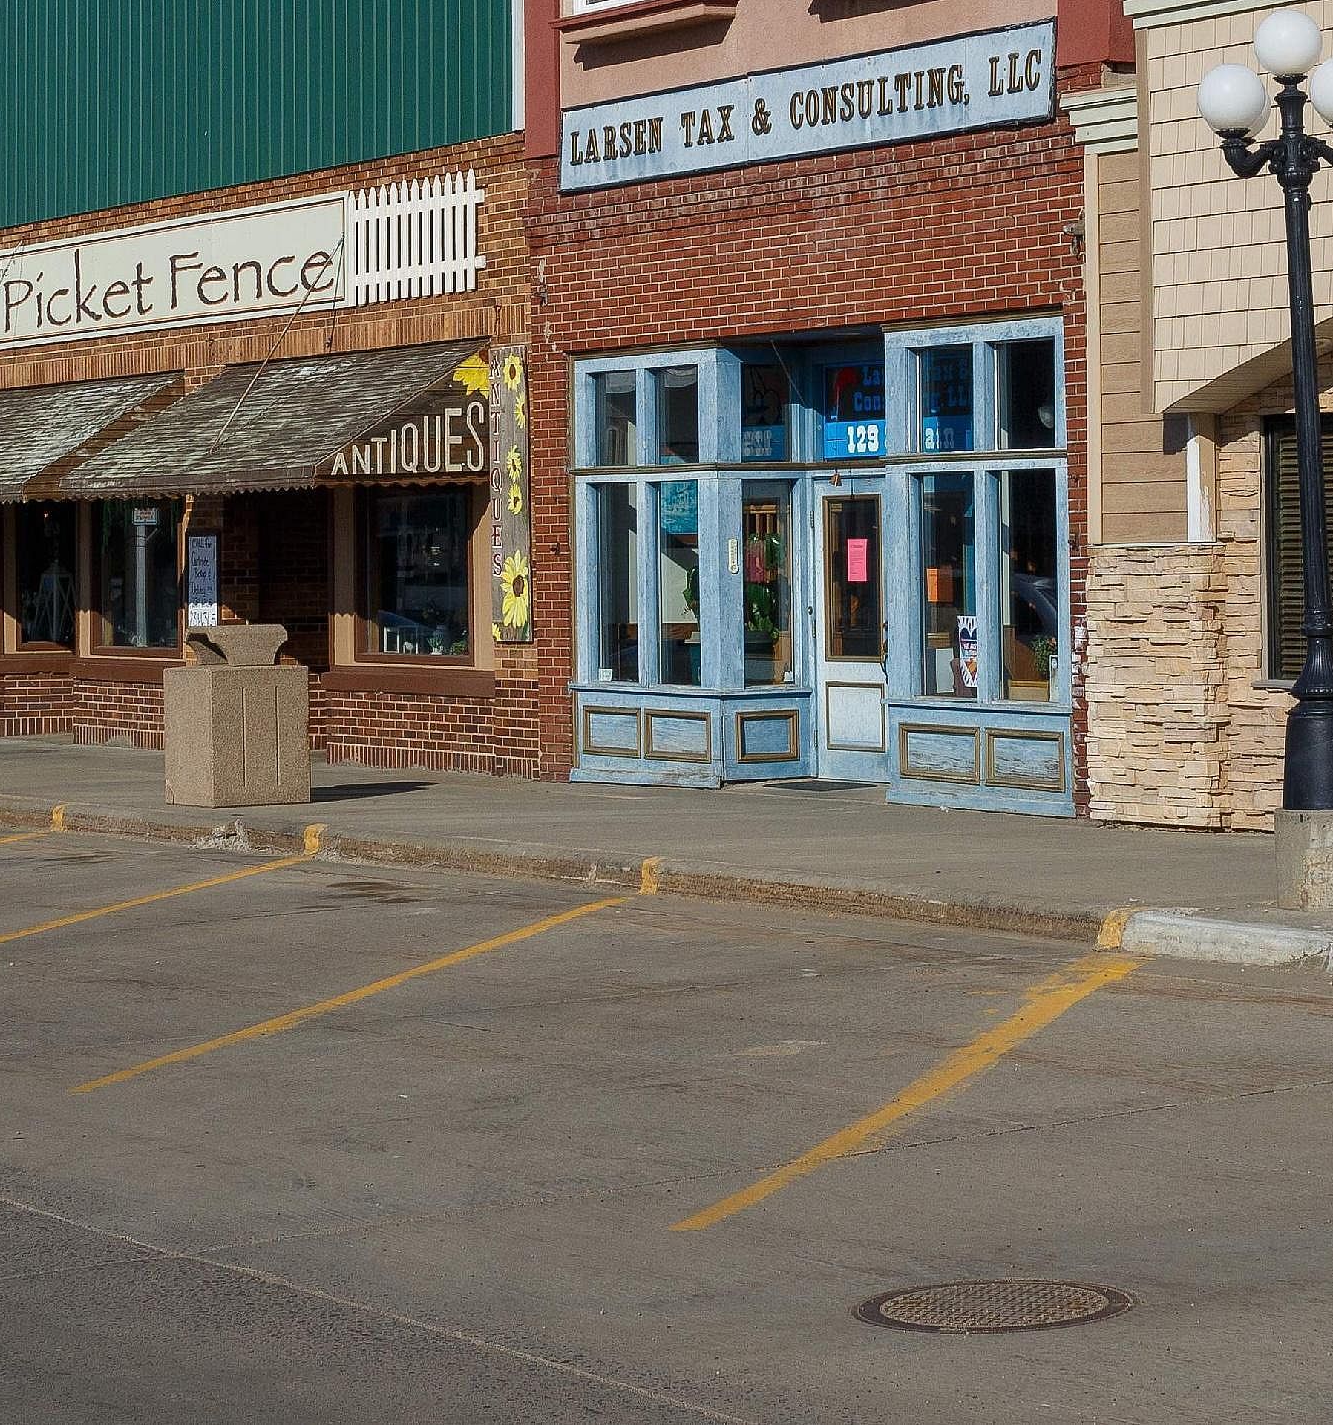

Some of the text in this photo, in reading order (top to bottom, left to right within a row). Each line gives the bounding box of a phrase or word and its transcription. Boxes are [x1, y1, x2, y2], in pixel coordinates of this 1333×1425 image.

[569, 48, 1042, 166] LARSEN TAX & CONSULTING, LLC
[3, 249, 335, 333] Picket Fence
[330, 401, 485, 475] ANTIQUES
[488, 355, 503, 576] ANTIQUES
[847, 424, 879, 454] 129
